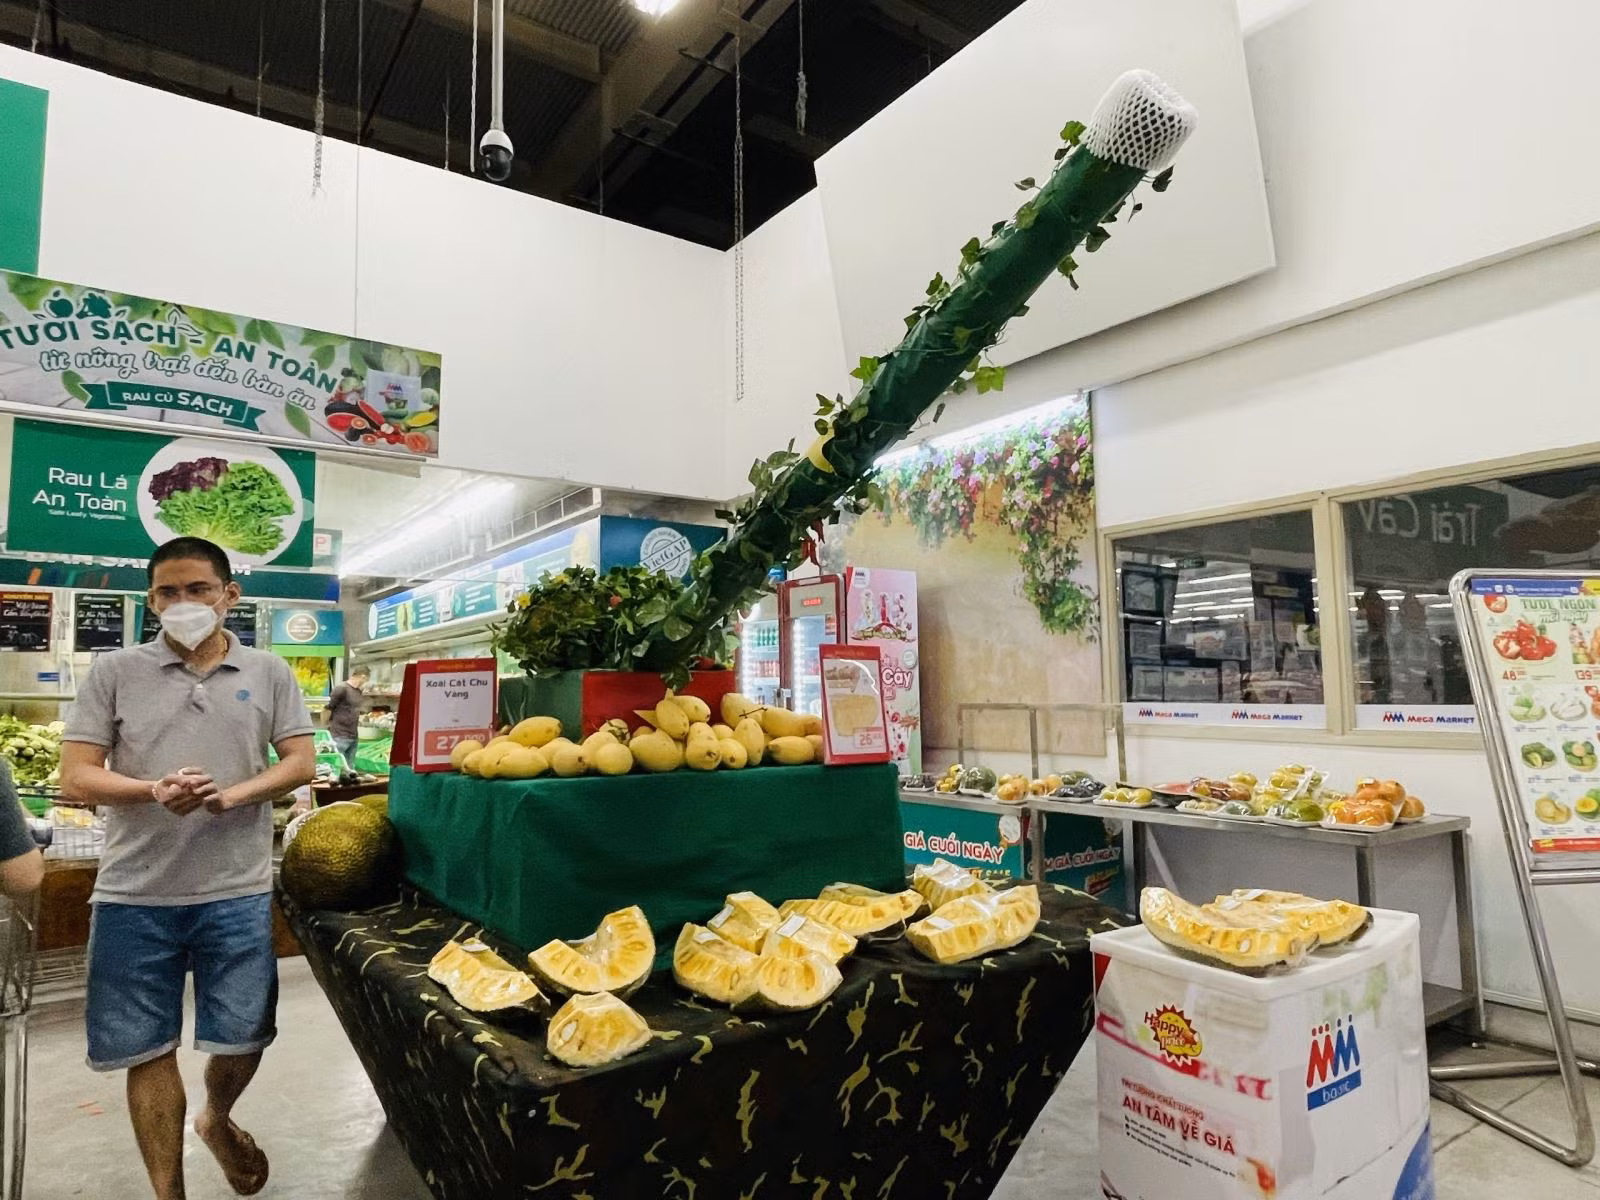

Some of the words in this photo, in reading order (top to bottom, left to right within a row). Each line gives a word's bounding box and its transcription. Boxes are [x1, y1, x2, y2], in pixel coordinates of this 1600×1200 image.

[90, 319, 177, 346] SẠCH
[214, 337, 257, 363] AN
[267, 350, 338, 394] TOÀN
[39, 350, 71, 372] từ
[74, 346, 139, 380] nông
[143, 350, 191, 378] trại
[193, 356, 238, 384] đến
[242, 368, 285, 398] bàn
[287, 388, 316, 411] ăn
[122, 391, 151, 402] RAU
[154, 390, 174, 403] CỦ
[177, 391, 234, 417] SẠCH
[48, 466, 93, 488] Rau
[100, 471, 128, 490] Lá
[32, 489, 66, 508] An
[74, 491, 127, 513] Toàn
[881, 666, 913, 689] Cây
[904, 831, 927, 851] GIÁ
[928, 832, 961, 857] CUỐI
[962, 841, 1005, 865] NGÀY
[1144, 1011, 1185, 1037] Happy
[1122, 1094, 1142, 1115] AN
[1144, 1105, 1176, 1131] TÂM
[1204, 1132, 1236, 1155] GIÁ
